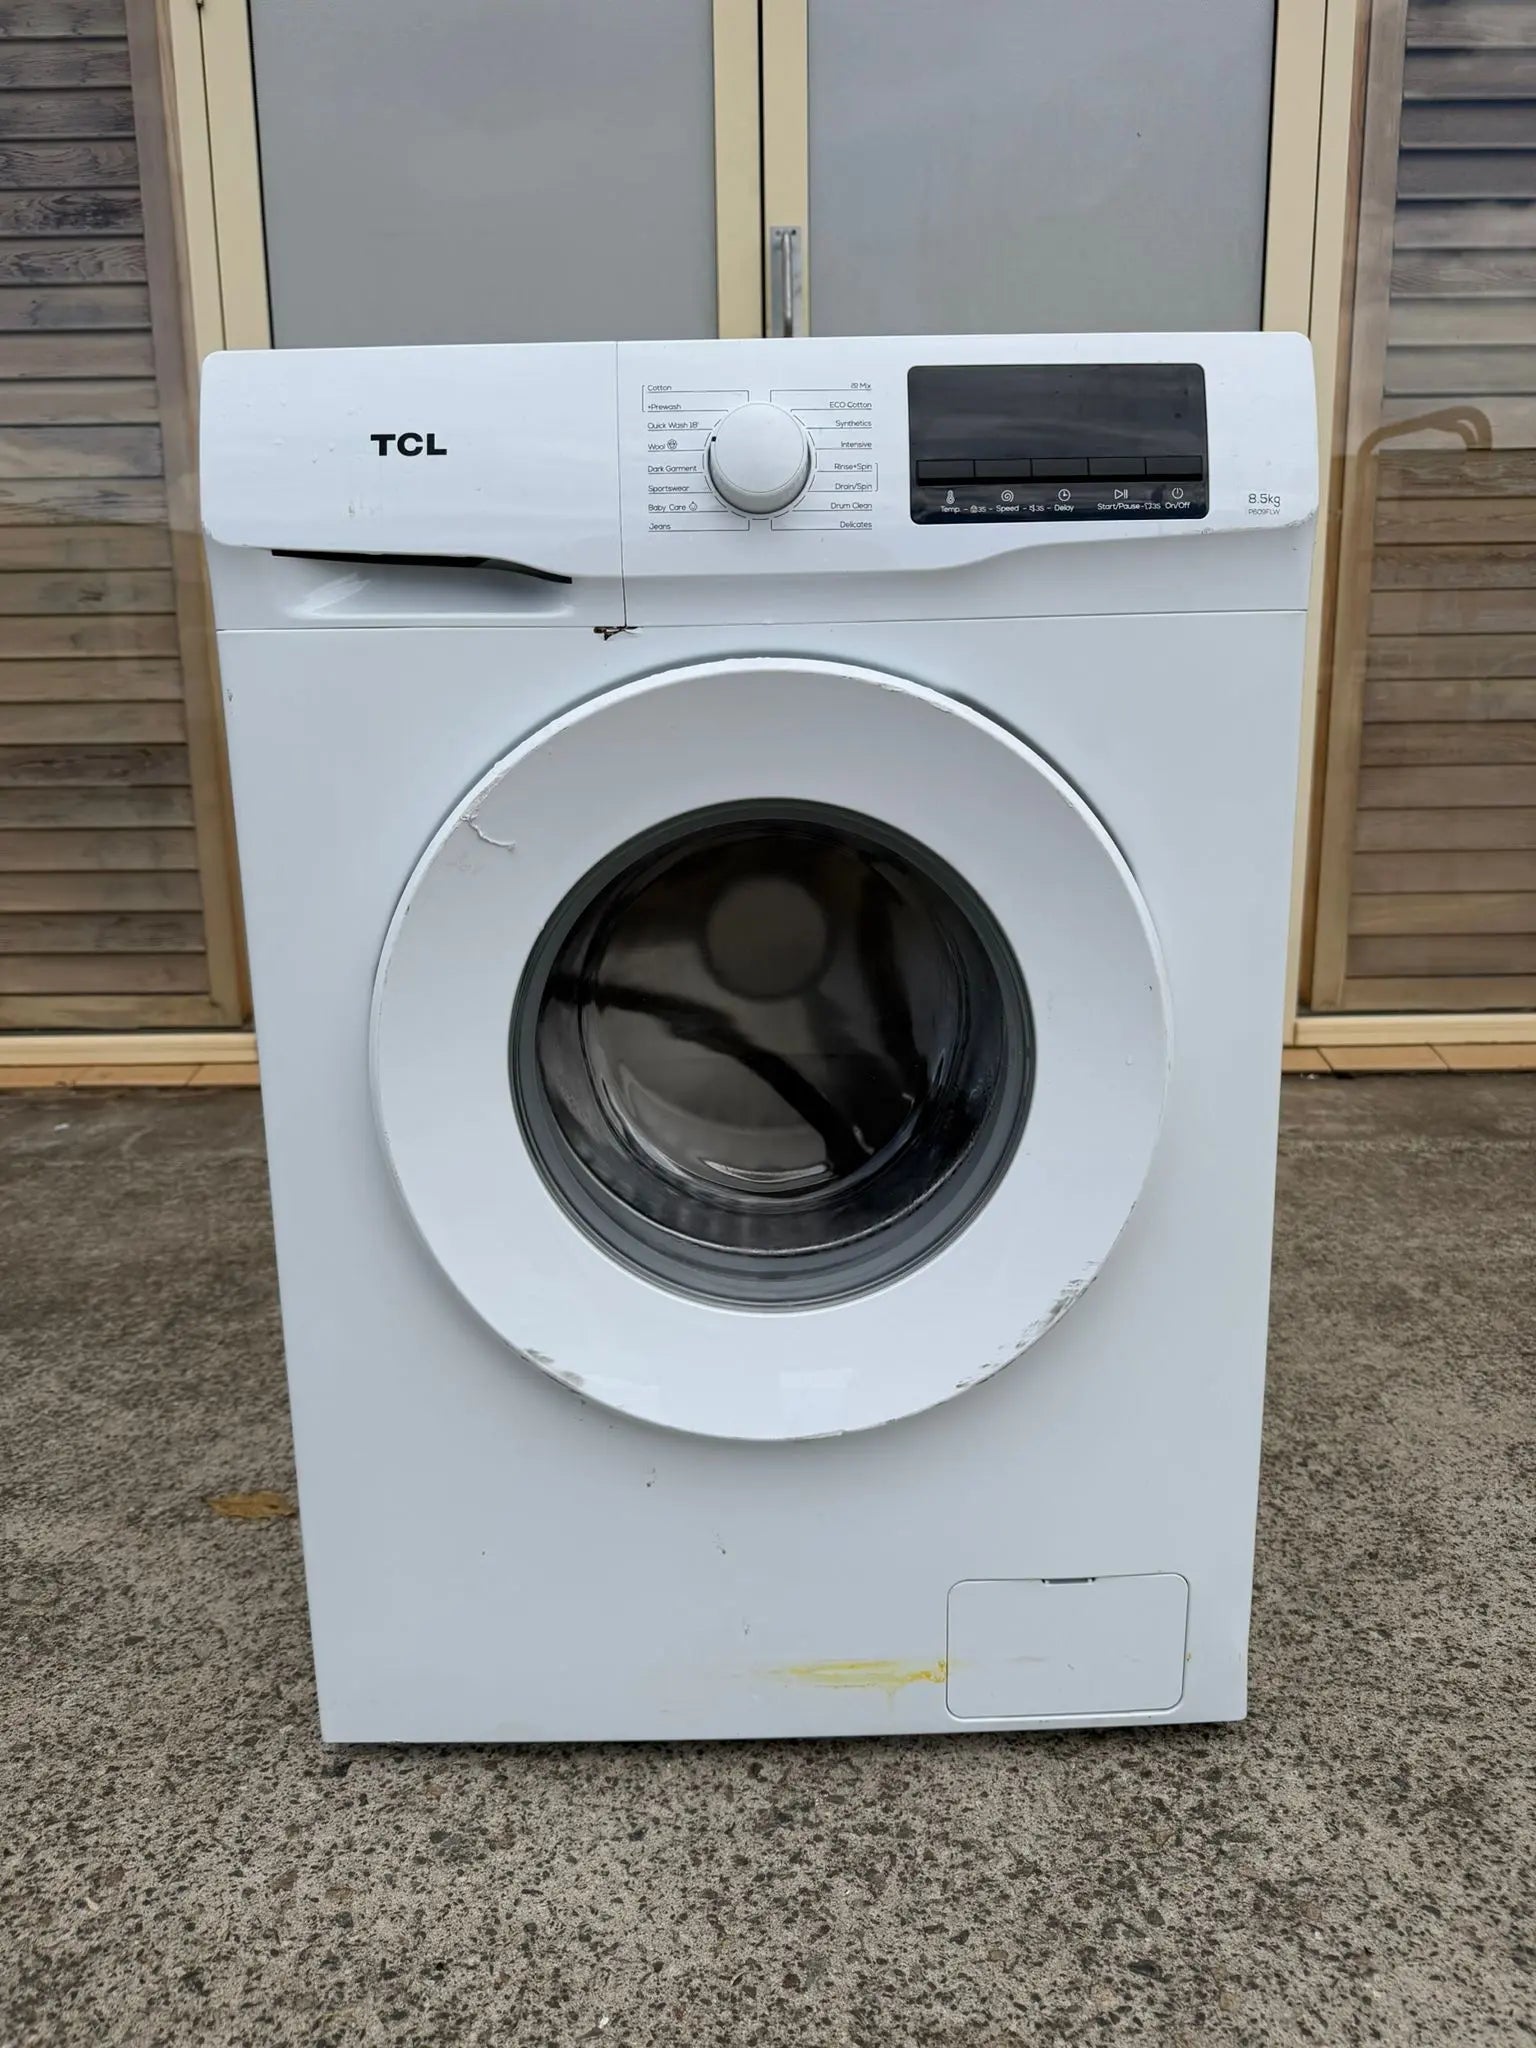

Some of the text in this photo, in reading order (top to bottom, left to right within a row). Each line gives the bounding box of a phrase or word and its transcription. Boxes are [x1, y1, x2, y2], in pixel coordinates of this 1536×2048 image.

[647, 403, 681, 411] +Prewash
[370, 432, 447, 457] TCL
[834, 463, 872, 471] Rinse+Spin
[835, 483, 872, 491] Drain/Spin
[1248, 493, 1281, 508] 8.5kg
[830, 502, 850, 510] Drum
[995, 504, 1020, 513] Speed
[1054, 504, 1075, 512] Delay
[1097, 502, 1141, 511] Start/Pause
[1165, 501, 1191, 510] On/Off
